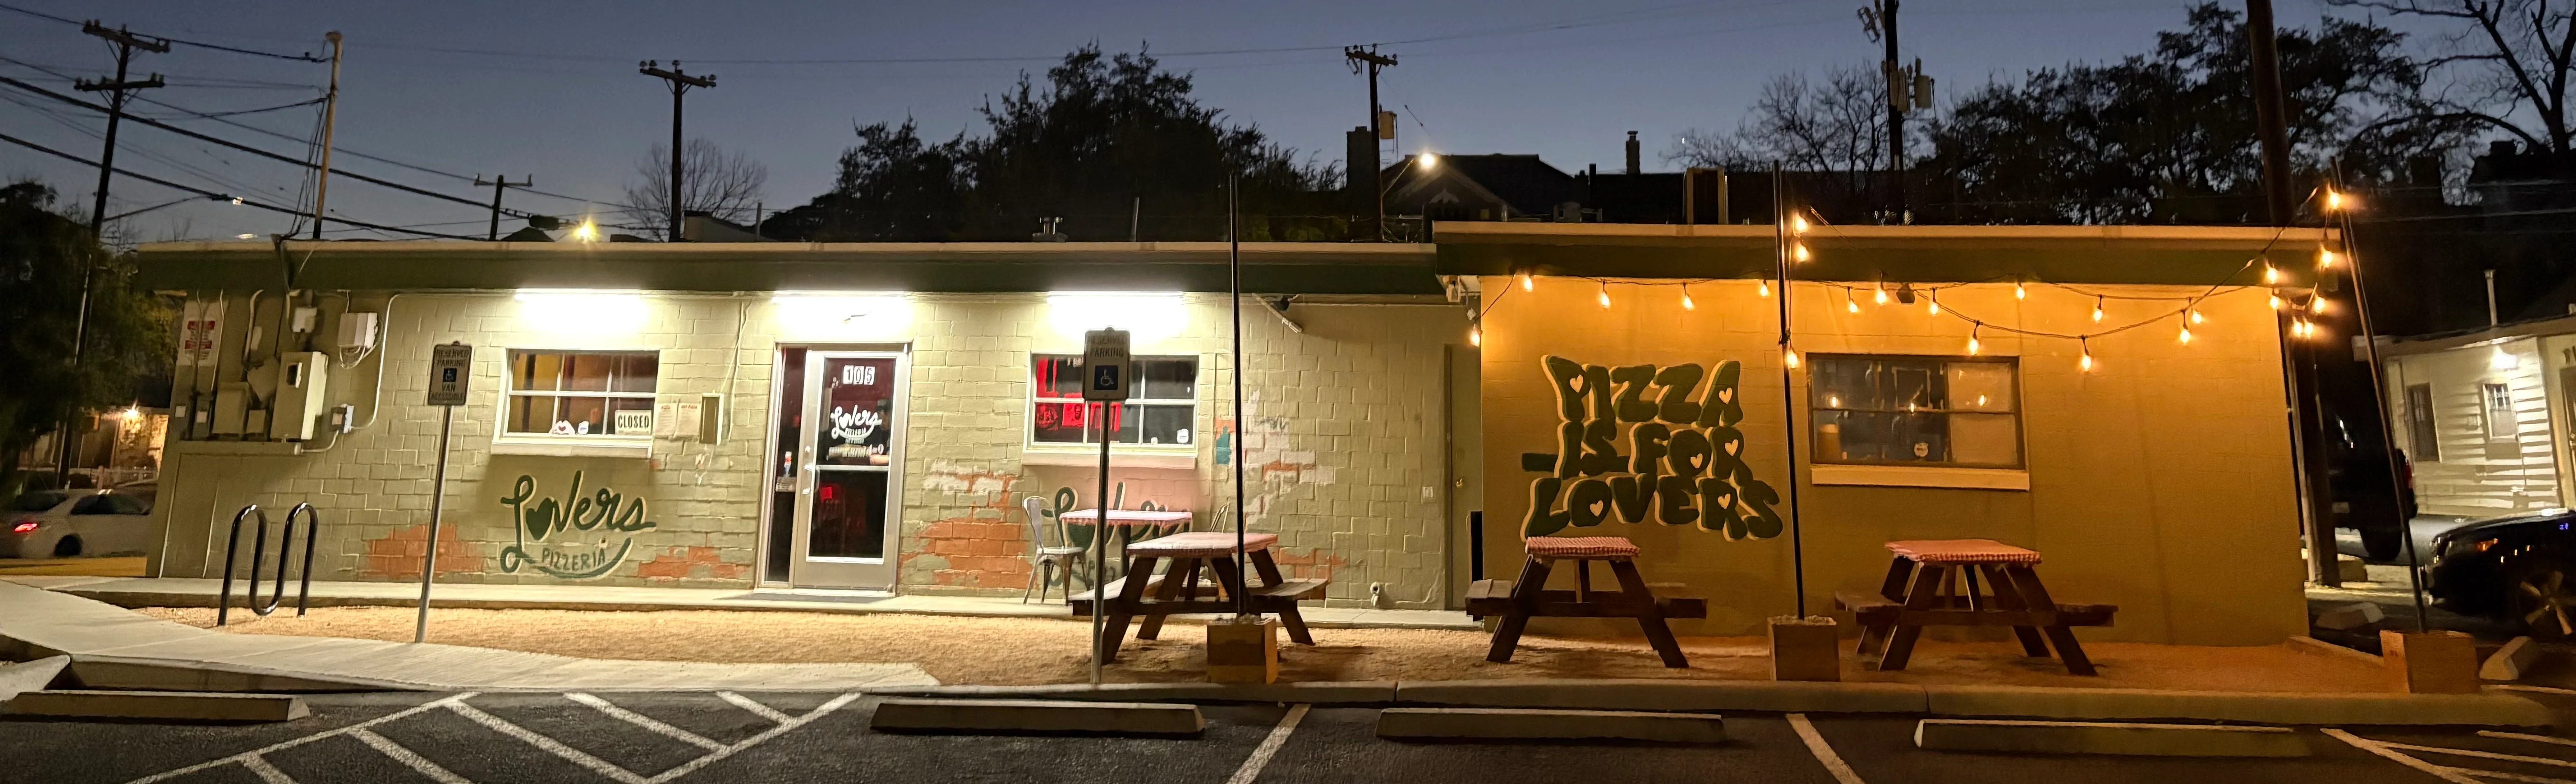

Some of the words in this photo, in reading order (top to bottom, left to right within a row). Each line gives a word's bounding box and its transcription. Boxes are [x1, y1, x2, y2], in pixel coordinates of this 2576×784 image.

[1091, 348, 1124, 358] PARKING
[442, 384, 456, 392] VAN
[847, 367, 874, 385] 105
[1541, 354, 1743, 428] PIZZA
[618, 415, 649, 428] CLOSED
[830, 405, 882, 439] Lovers
[1554, 419, 1618, 480] IS
[1628, 421, 1753, 487] FOR
[500, 470, 657, 573] Lovers
[1520, 473, 1783, 541] LOVERS
[542, 547, 605, 572] PIZZERIA
